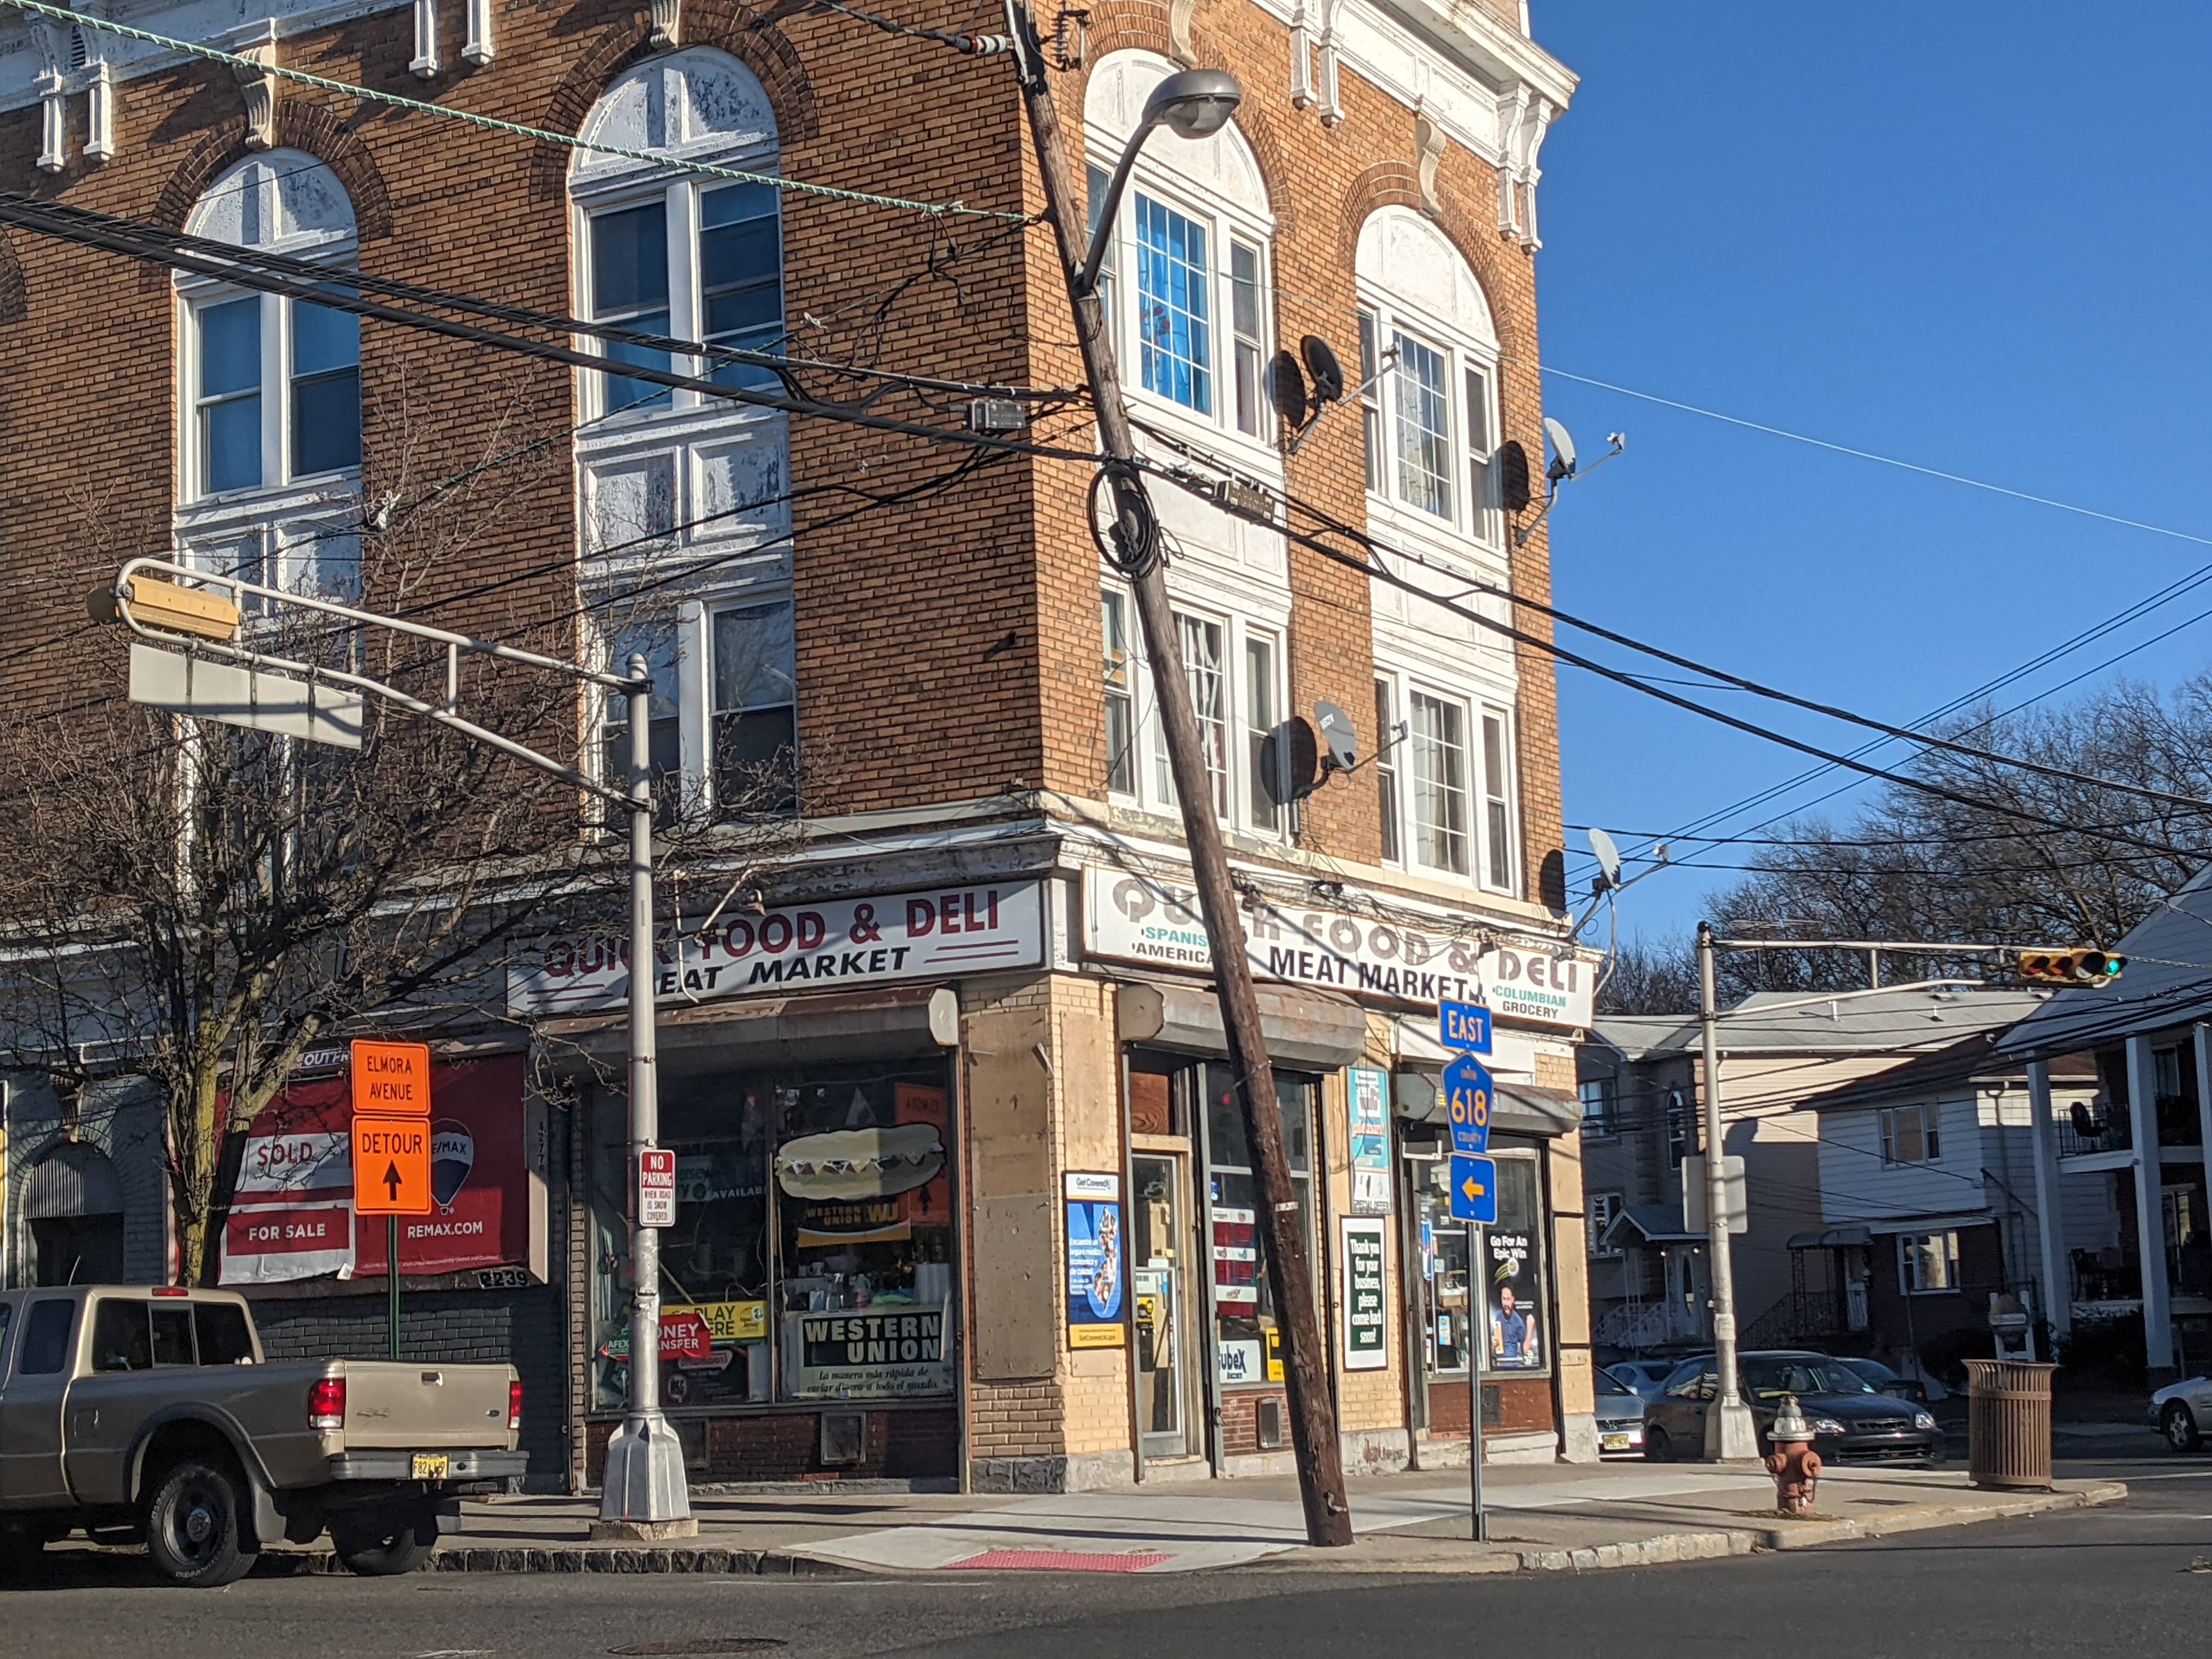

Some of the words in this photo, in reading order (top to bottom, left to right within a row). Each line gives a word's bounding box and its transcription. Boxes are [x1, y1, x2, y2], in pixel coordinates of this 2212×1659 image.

[701, 911, 826, 960] FOOD
[849, 904, 883, 944] &
[906, 890, 998, 938] DELI
[1302, 915, 1425, 965] FOOD
[1448, 941, 1479, 975] &
[1498, 950, 1577, 993] DELI
[623, 966, 723, 998] EAT
[749, 947, 911, 986] MARKET
[1269, 946, 1346, 987] MEAT
[1358, 963, 1468, 1000] MARKET
[1494, 985, 1566, 1007] COLUMBIAN
[1503, 1001, 1559, 1019] GROCERY
[1448, 1010, 1483, 1043] EAST
[367, 1056, 413, 1074] ELMORA
[370, 1084, 413, 1101] AVENUE
[1451, 1086, 1487, 1127] 618
[362, 1133, 422, 1154] DETOUR
[433, 1142, 466, 1155] E/MAX
[257, 1142, 313, 1166] SOLD
[650, 1155, 664, 1170] NO
[642, 1171, 672, 1186] PARKING
[1076, 1177, 1086, 1186] Get
[645, 1190, 657, 1199] WHEN
[659, 1190, 672, 1199] ROAD
[647, 1201, 652, 1210] IS
[654, 1201, 667, 1210] SNOW
[807, 1205, 861, 1218] WESTERN
[647, 1211, 668, 1221] COVERED
[825, 1215, 861, 1226] UNION
[249, 1225, 280, 1242] FOR
[285, 1223, 325, 1239] SALE
[408, 1221, 483, 1239] REMAX.COM
[1350, 1238, 1369, 1255] Thank
[1369, 1243, 1380, 1257] you
[1490, 1235, 1501, 1246] Go
[1502, 1235, 1515, 1246] For
[1516, 1235, 1528, 1246] An
[1493, 1248, 1510, 1261] Epic
[1510, 1248, 1527, 1259] Win
[1355, 1256, 1365, 1272] for
[1365, 1260, 1379, 1277] your
[1358, 1291, 1378, 1312] please
[694, 1305, 736, 1321] PLAY
[1352, 1313, 1369, 1325] come
[1369, 1308, 1382, 1325] back
[708, 1321, 735, 1336] ERE
[805, 1316, 940, 1342] WESTERN
[847, 1339, 940, 1363] UNION
[918, 1367, 928, 1376] de
